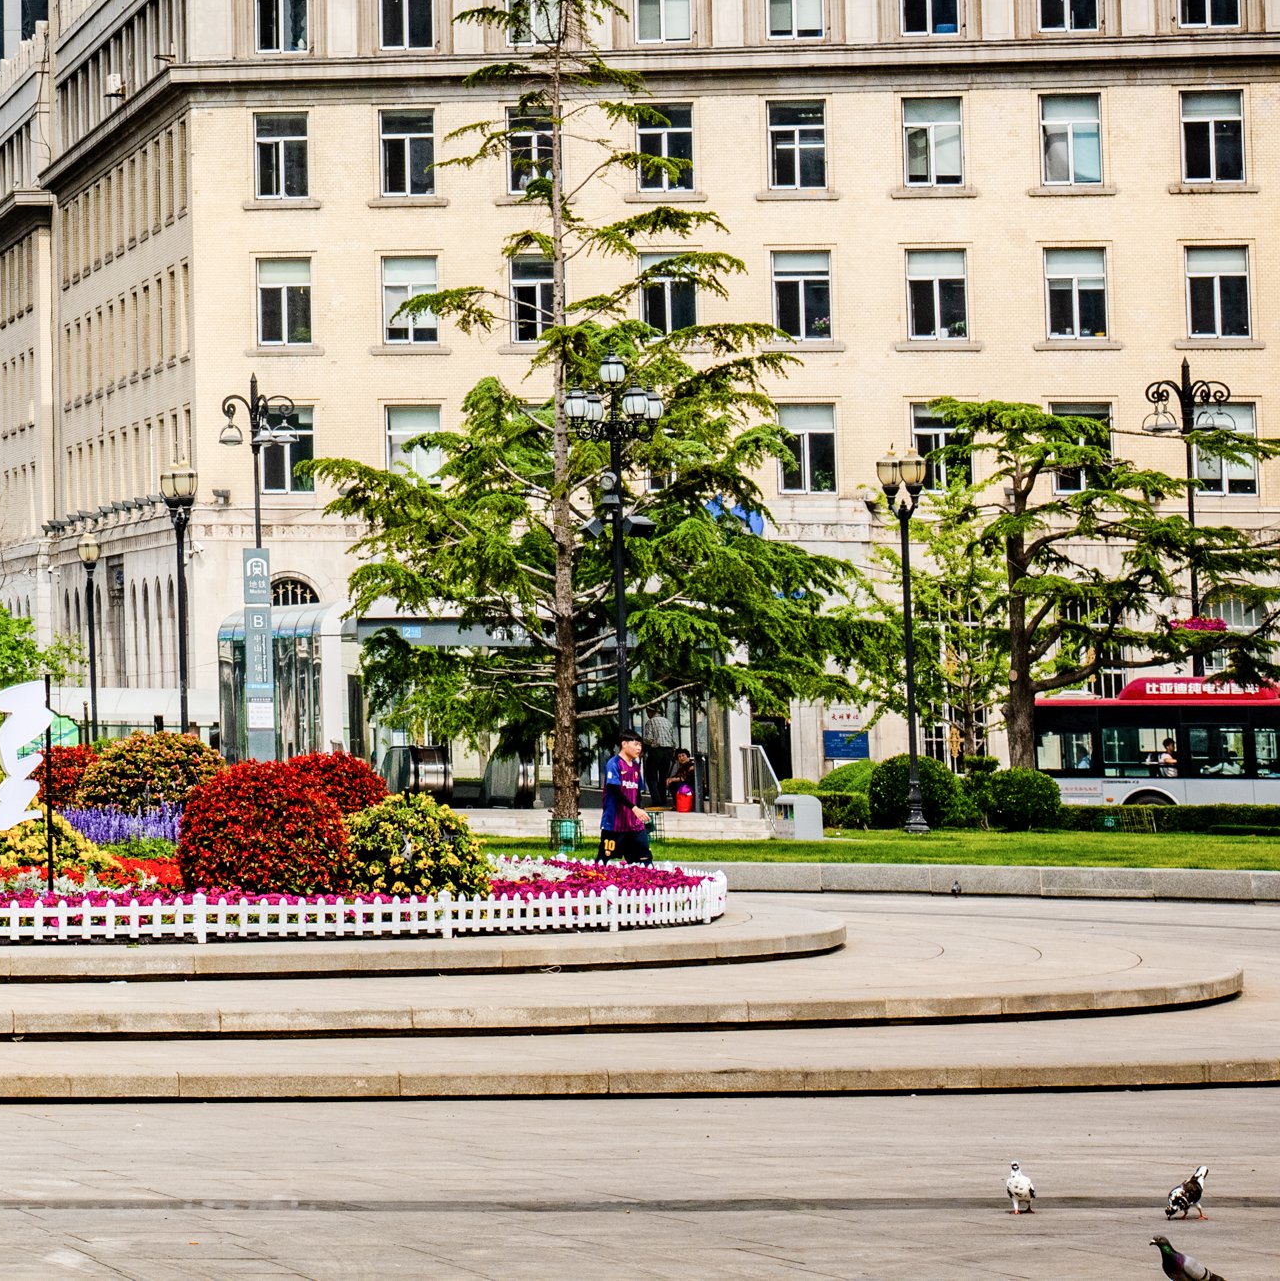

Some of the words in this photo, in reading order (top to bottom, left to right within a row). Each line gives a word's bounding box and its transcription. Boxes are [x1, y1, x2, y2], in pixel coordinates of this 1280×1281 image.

[249, 580, 267, 589] 地铁
[253, 615, 264, 628] B
[604, 839, 616, 851] 10
